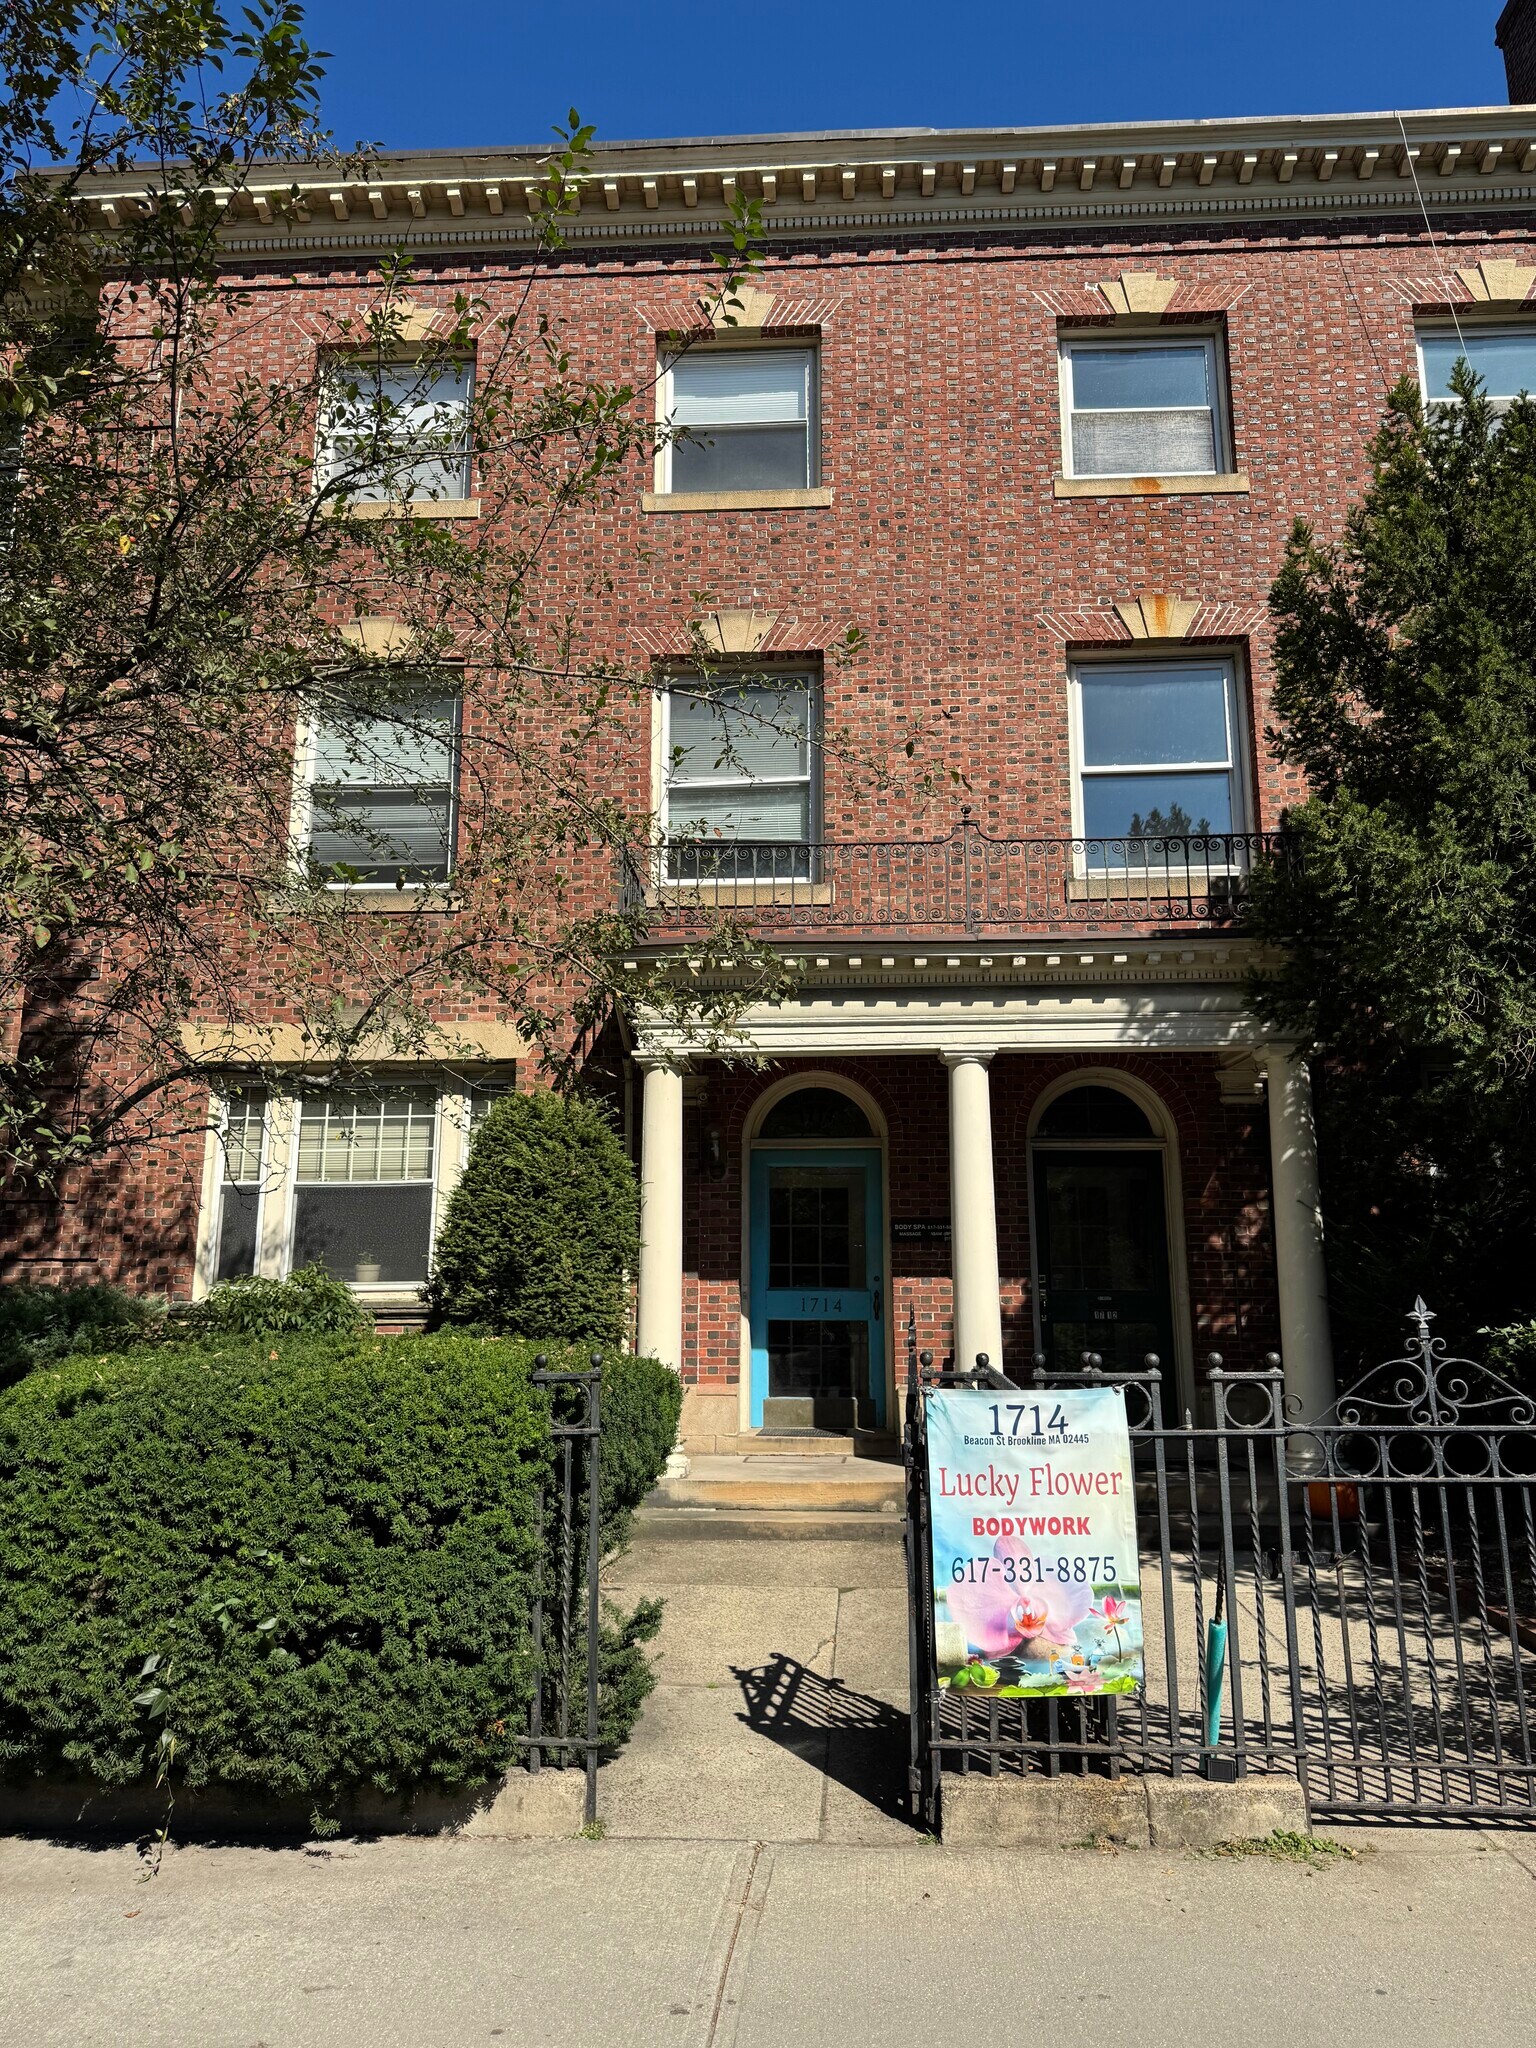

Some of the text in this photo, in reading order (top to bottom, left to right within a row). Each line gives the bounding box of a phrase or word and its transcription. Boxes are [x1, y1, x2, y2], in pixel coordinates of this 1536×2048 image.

[801, 1297, 842, 1313] 1714
[988, 1404, 1069, 1436] 1714
[964, 1433, 1089, 1446] Beacon St Brookline MA 02445
[938, 1463, 1123, 1506] Lucky Flower
[972, 1516, 1091, 1536] BODYWORK
[951, 1556, 1117, 1583] 617-331-8875
